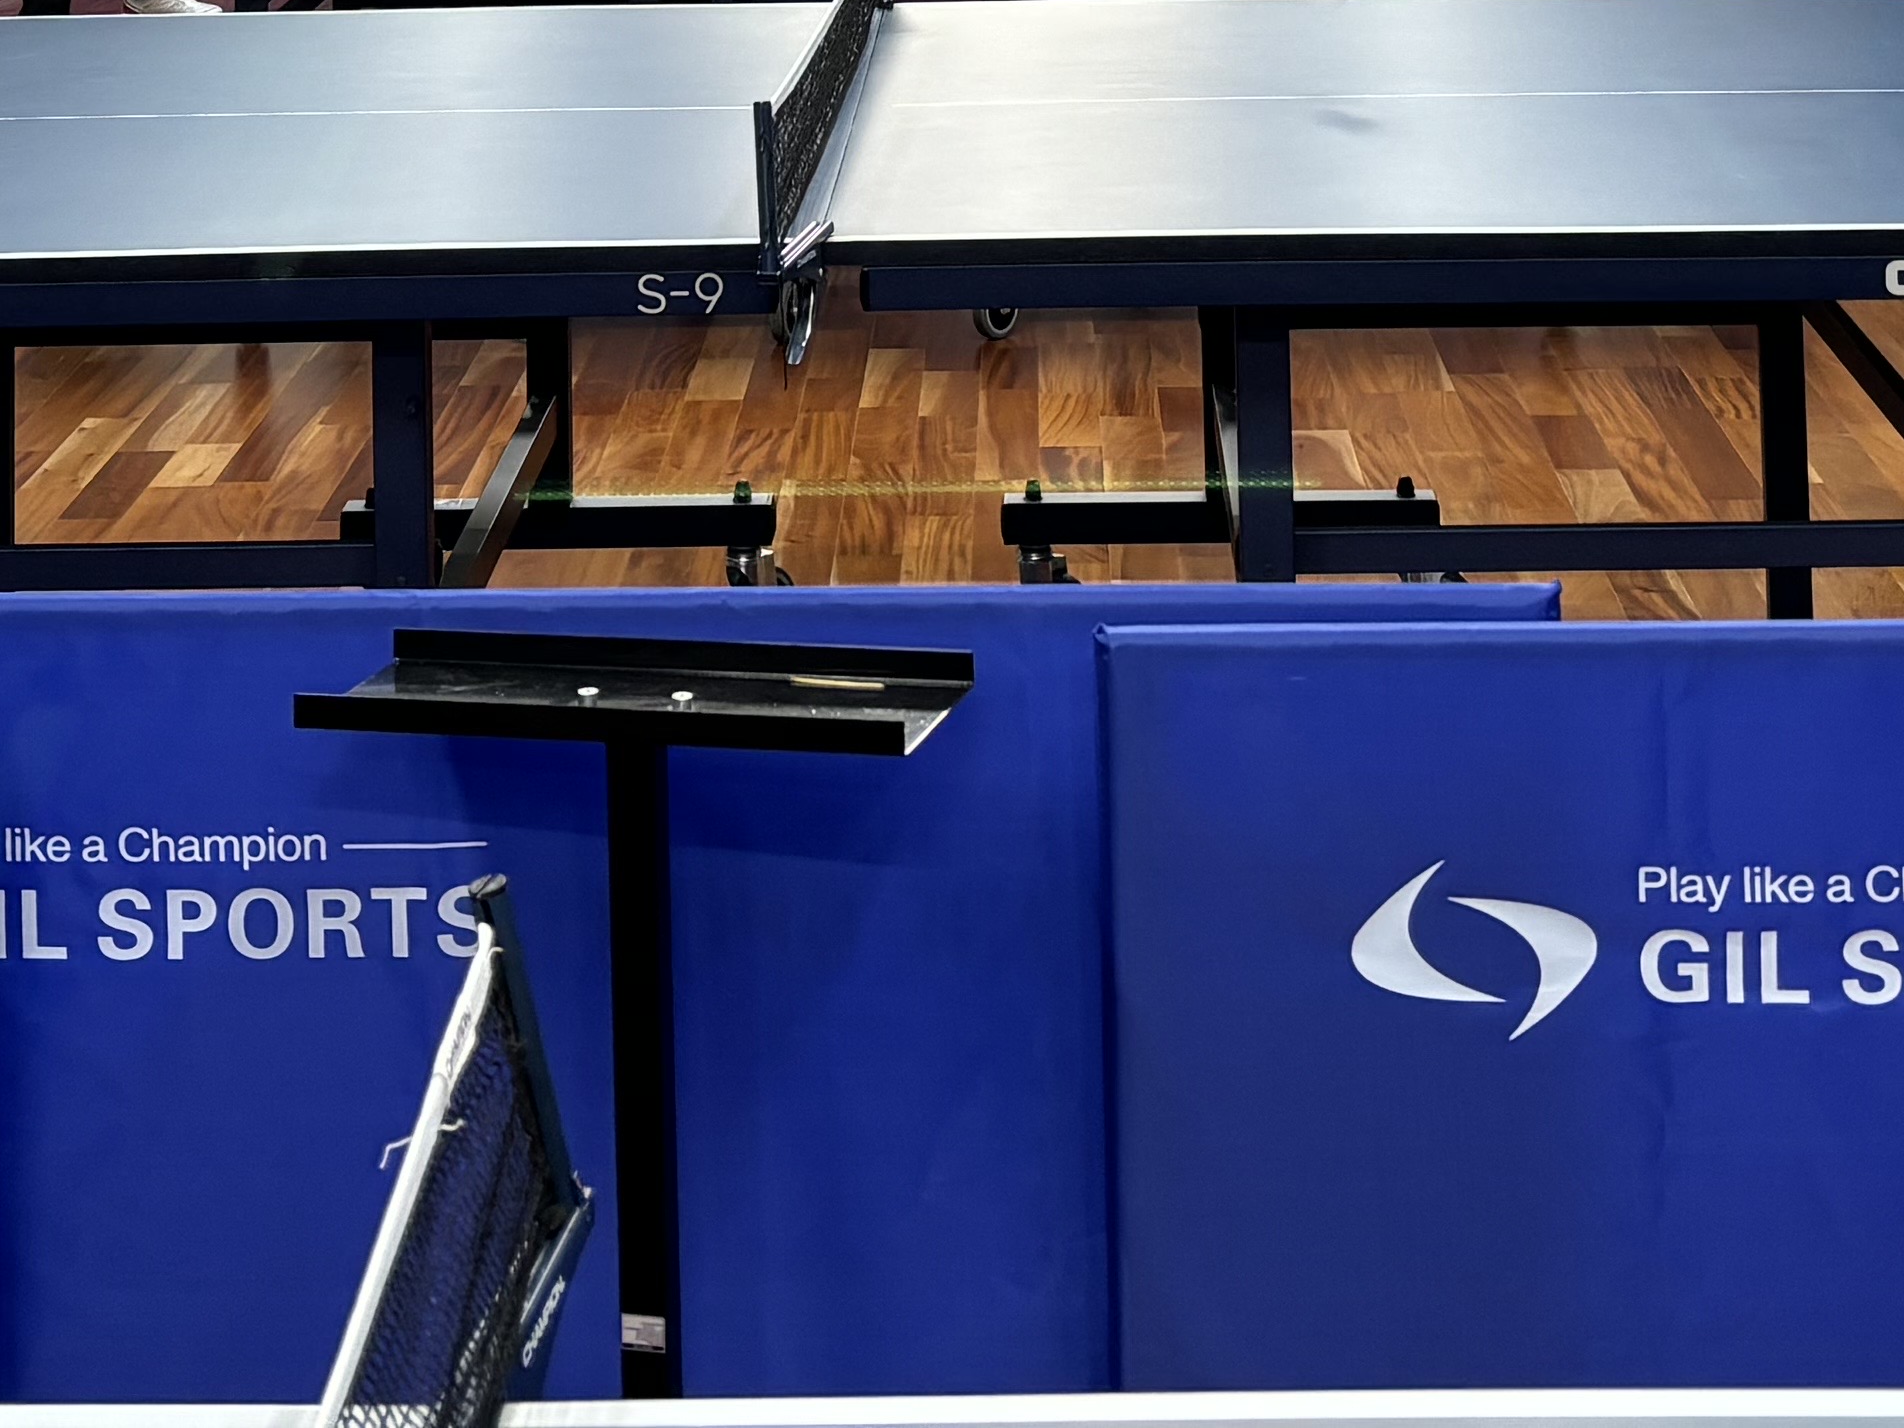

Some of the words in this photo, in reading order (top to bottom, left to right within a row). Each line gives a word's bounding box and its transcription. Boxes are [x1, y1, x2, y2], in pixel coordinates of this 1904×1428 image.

[637, 272, 724, 314] S-9
[5, 827, 71, 862] like
[81, 835, 109, 863] a
[118, 826, 327, 871] Champion
[1638, 866, 1732, 913] Play
[1743, 866, 1815, 904] like
[1826, 874, 1855, 903] a
[1639, 929, 1811, 1005] GIL
